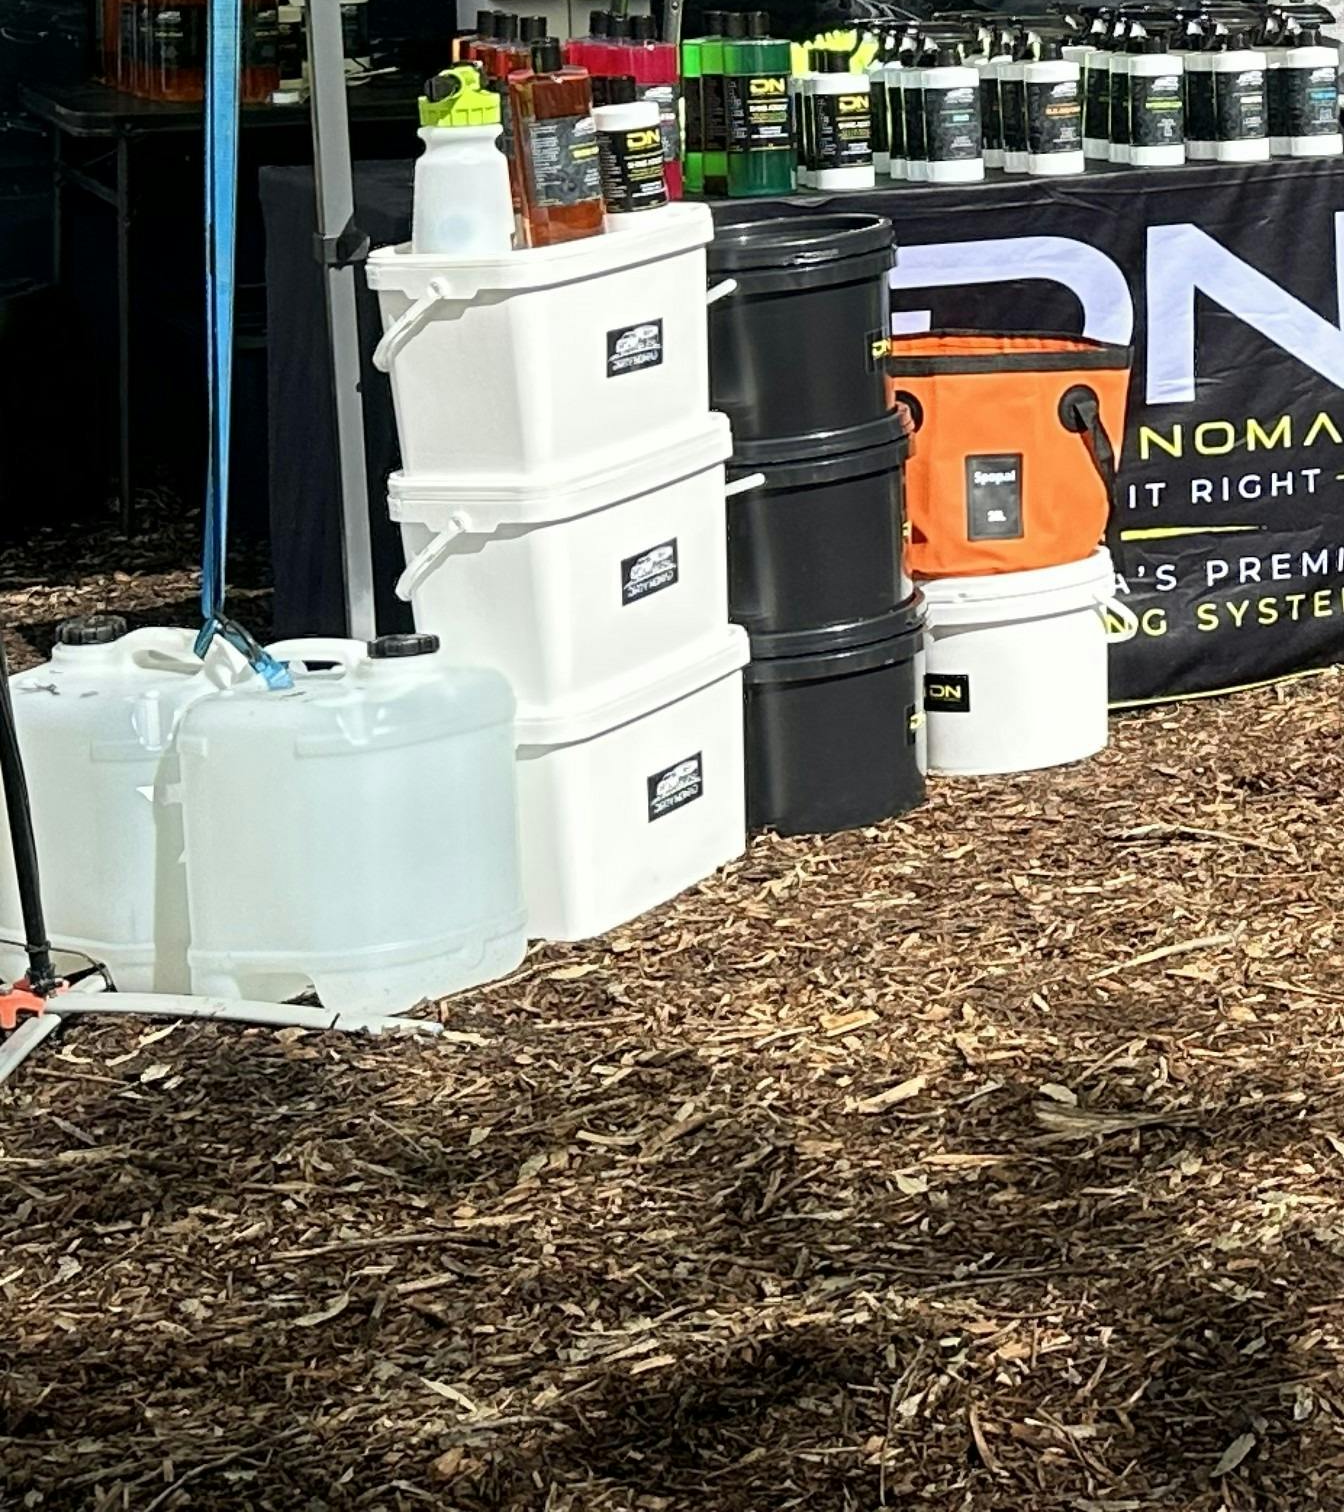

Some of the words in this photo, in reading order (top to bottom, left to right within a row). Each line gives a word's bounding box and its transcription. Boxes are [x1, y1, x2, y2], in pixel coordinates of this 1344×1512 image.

[1129, 482, 1167, 509] IT
[1191, 468, 1321, 504] RIGHT
[929, 684, 961, 699] DN
